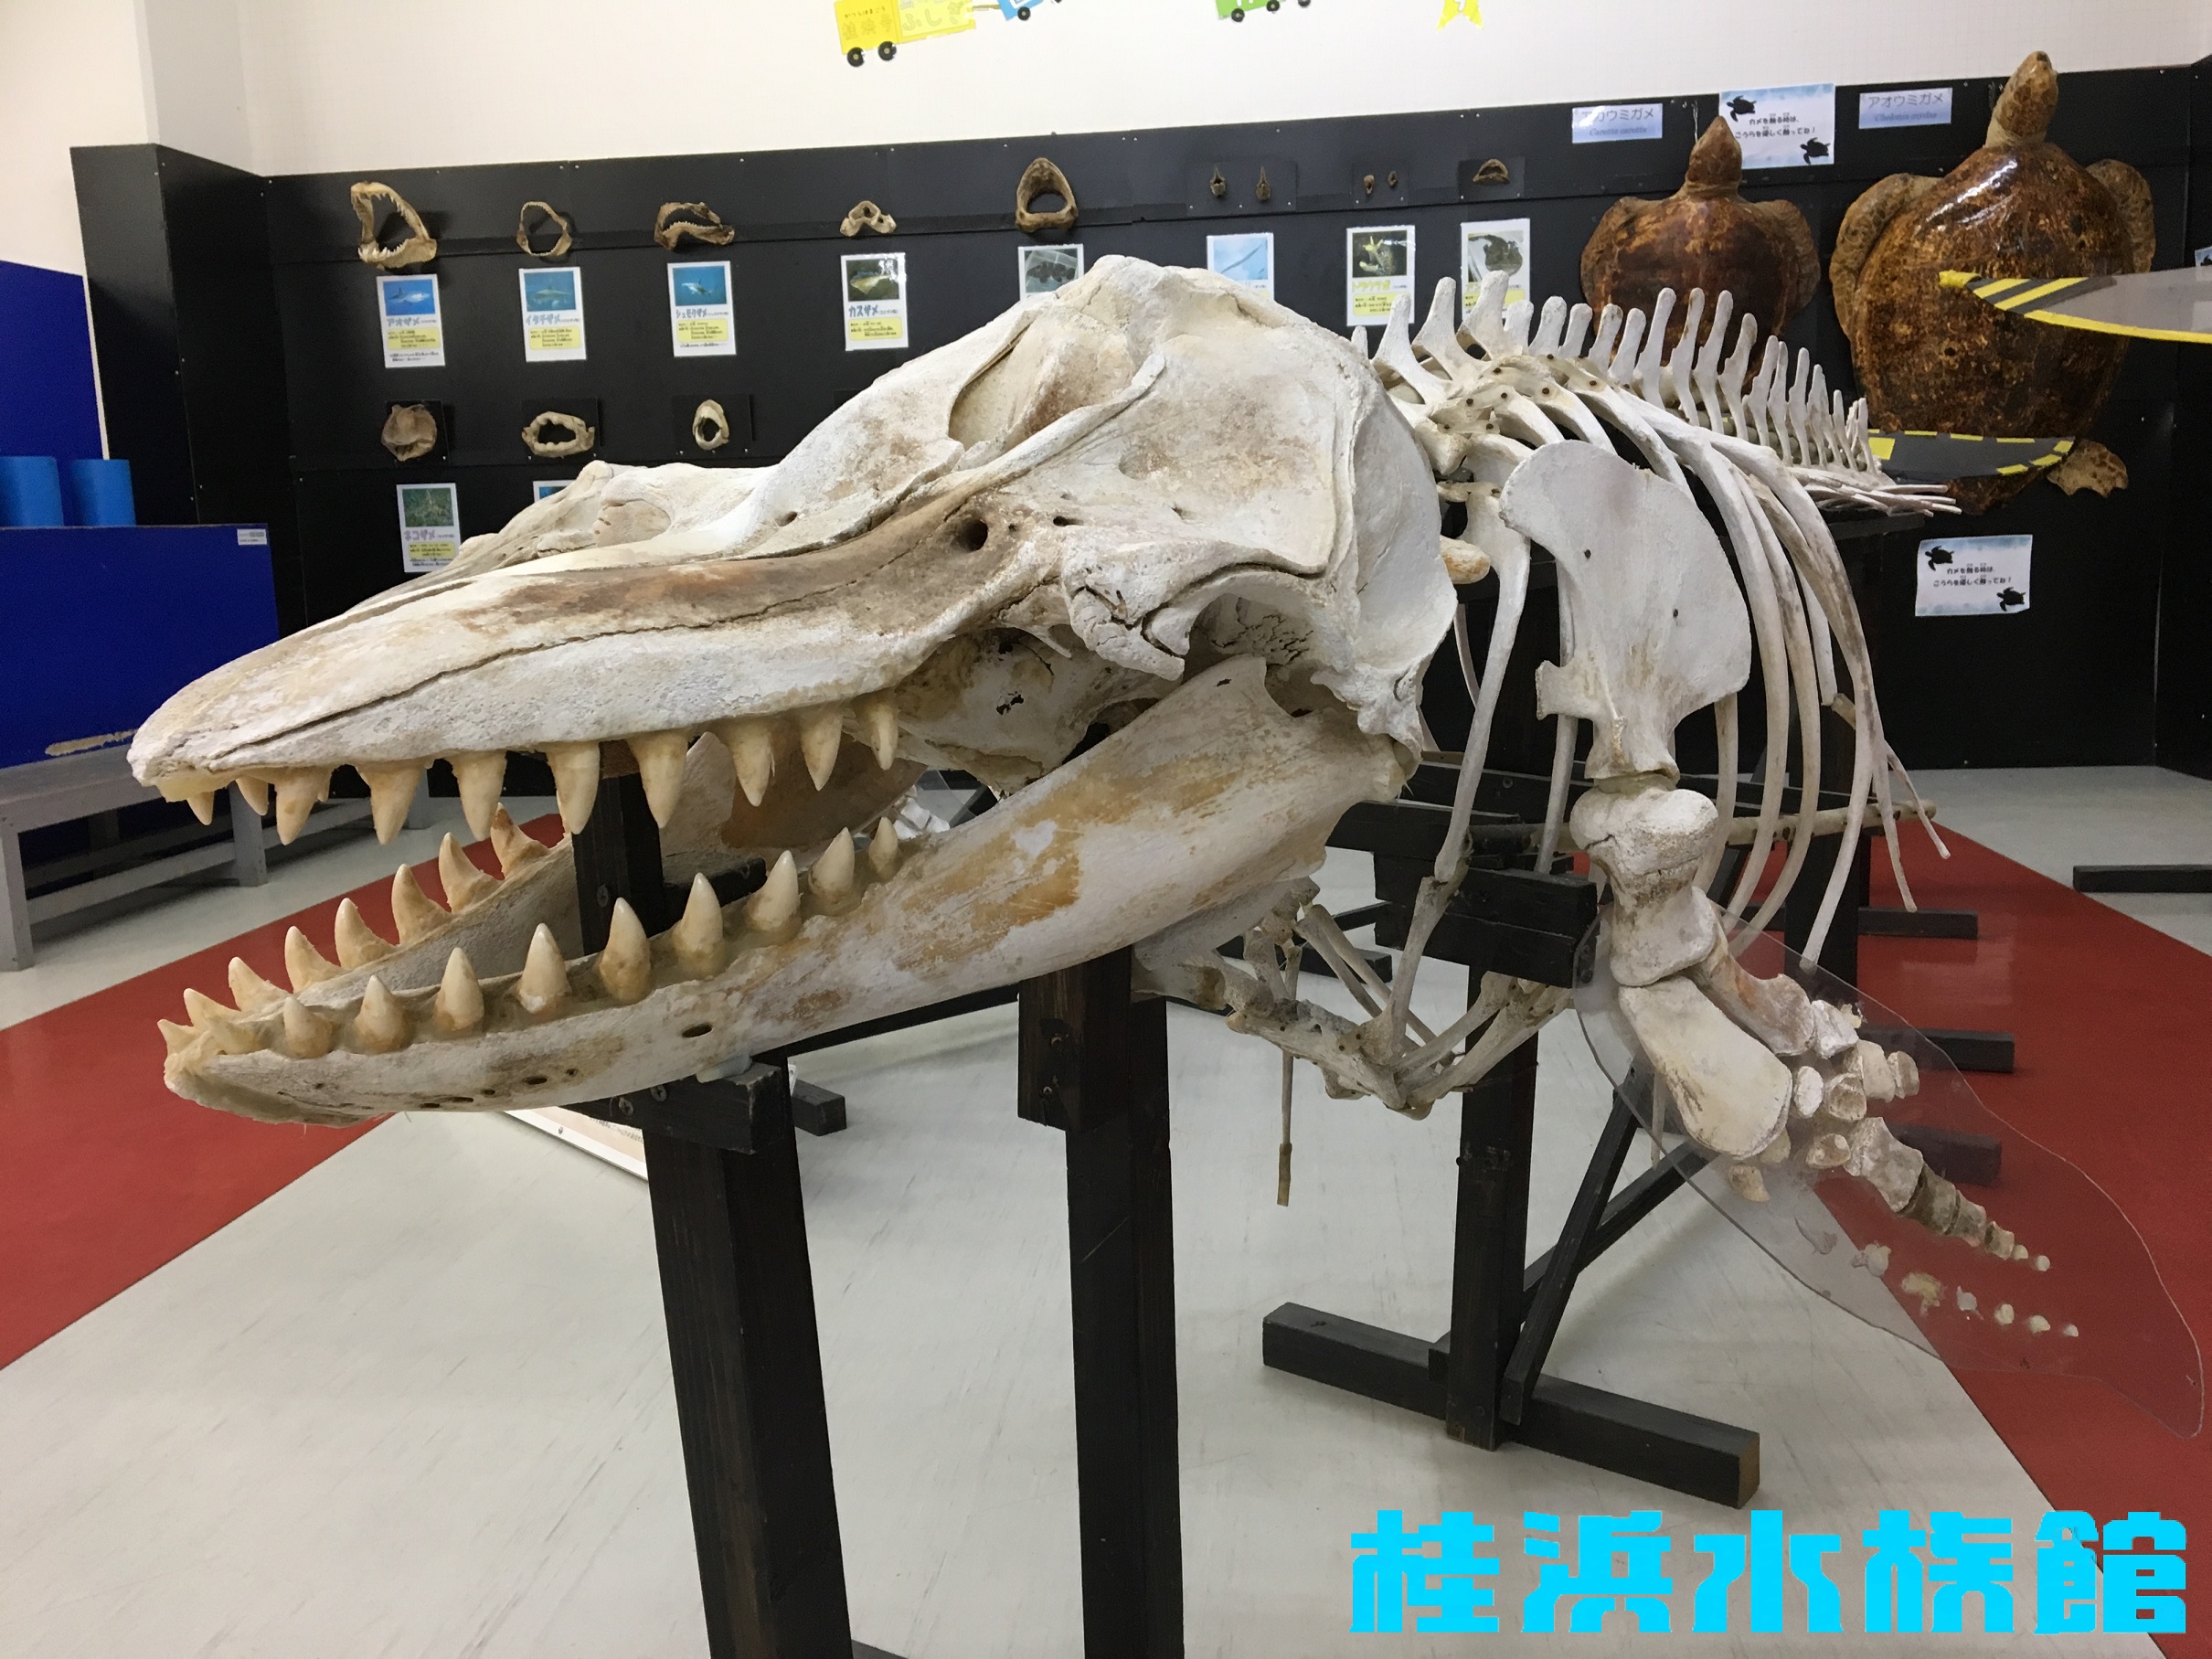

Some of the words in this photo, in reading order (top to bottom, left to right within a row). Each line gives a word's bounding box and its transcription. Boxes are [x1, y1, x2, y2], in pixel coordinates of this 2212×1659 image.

[1867, 92, 1943, 109] アオウミガメ
